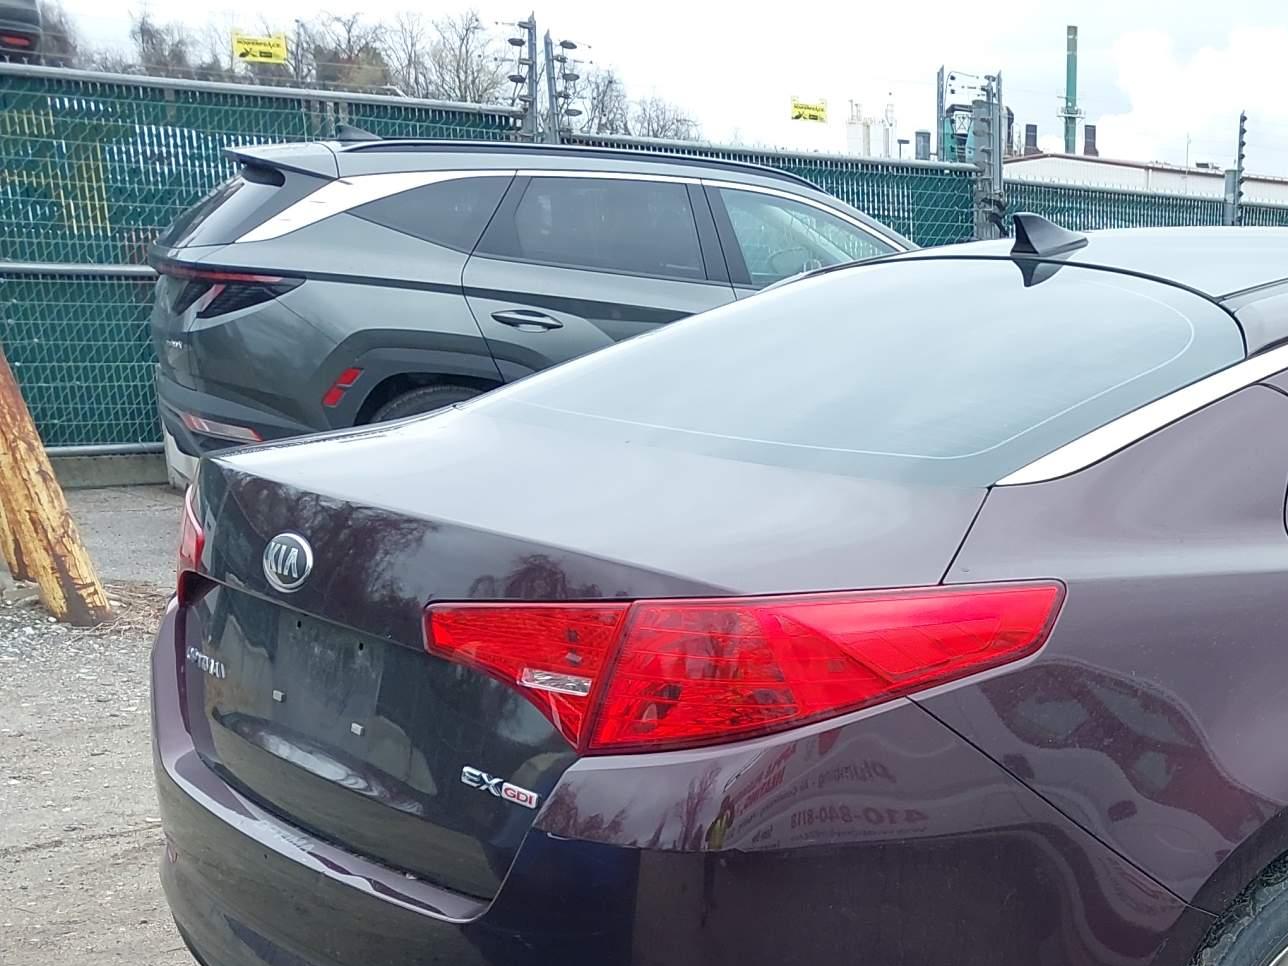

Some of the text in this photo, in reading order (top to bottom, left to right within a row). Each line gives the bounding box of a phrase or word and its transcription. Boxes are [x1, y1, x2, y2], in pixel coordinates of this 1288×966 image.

[267, 541, 300, 579] KIA
[460, 765, 537, 808] EX GDI
